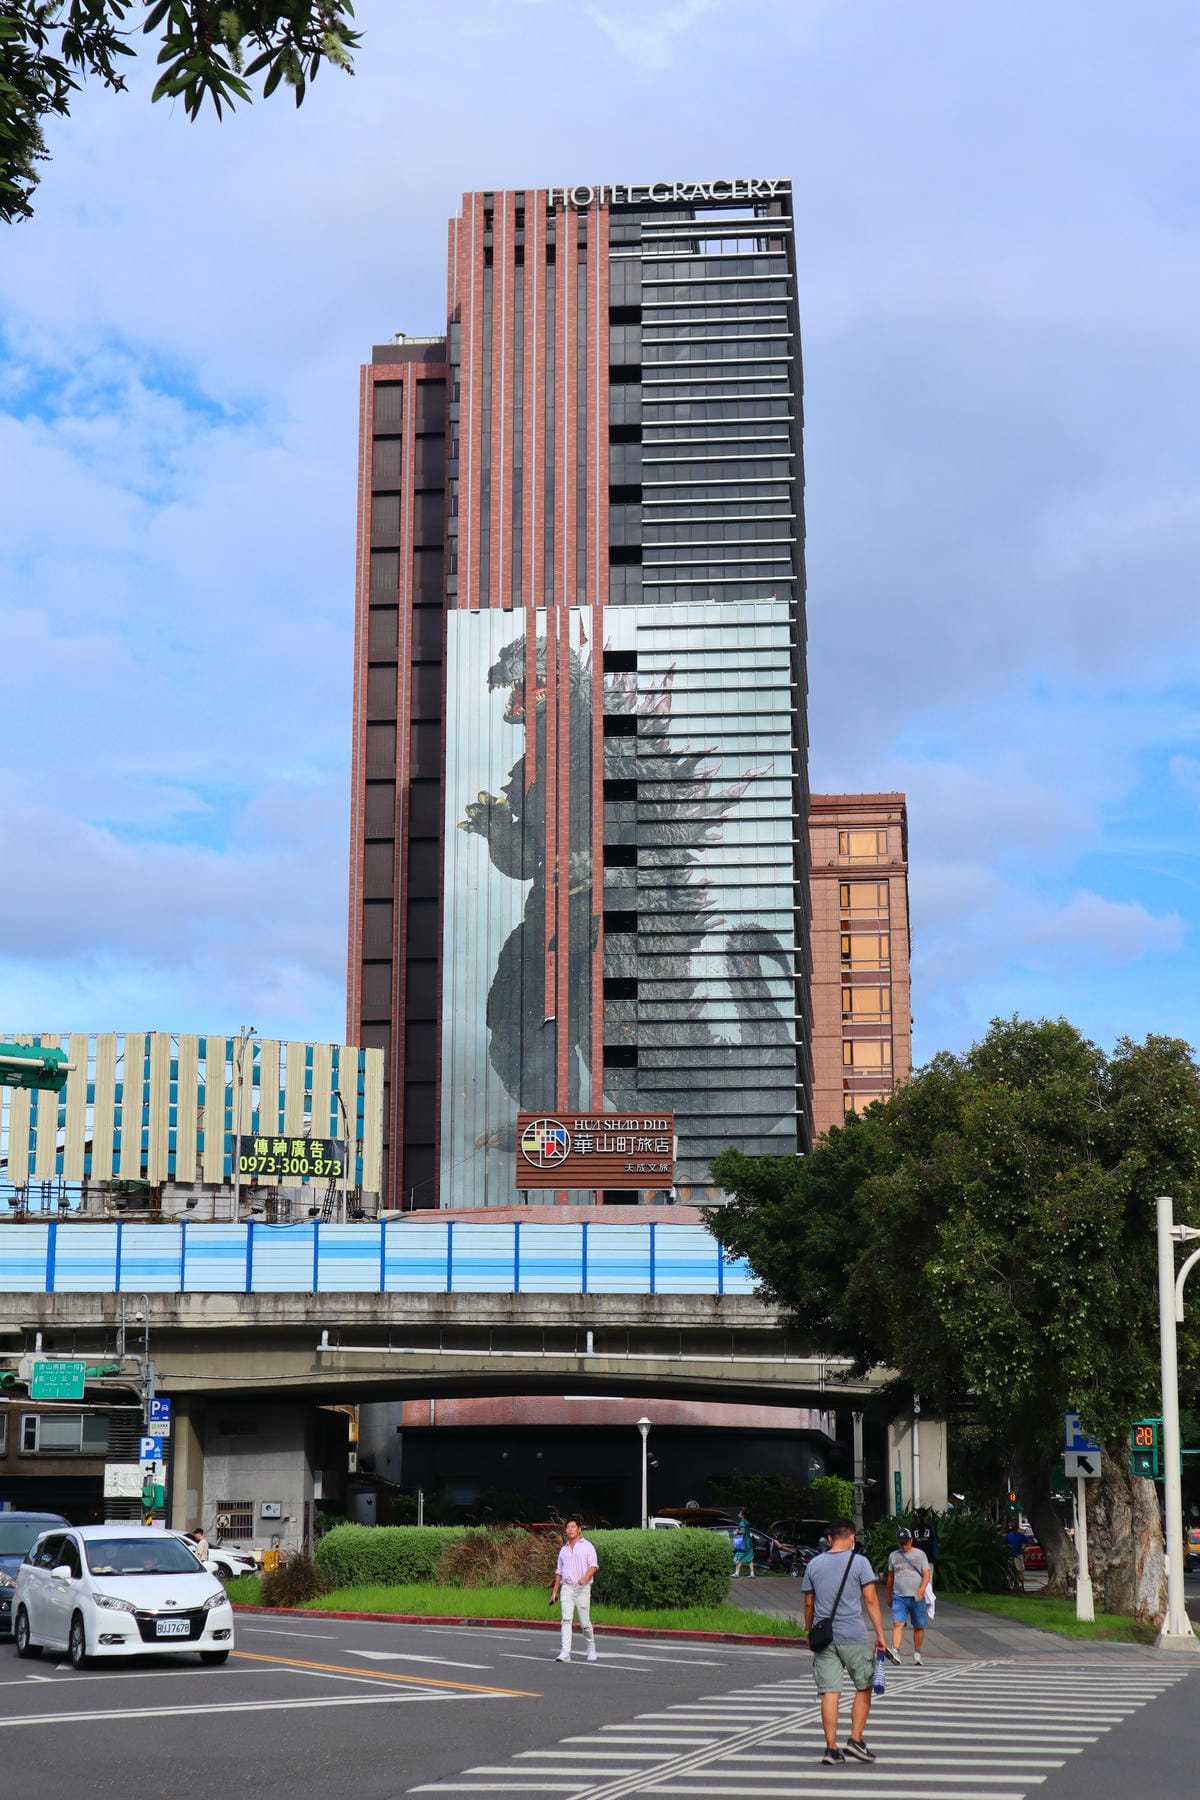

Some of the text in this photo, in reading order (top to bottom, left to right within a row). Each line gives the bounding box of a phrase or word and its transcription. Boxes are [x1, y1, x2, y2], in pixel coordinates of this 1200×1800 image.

[548, 178, 782, 207] HOTEL GRACERY
[574, 1120, 668, 1130] HUA SHAN DIN
[254, 1138, 324, 1158] 傳神廣告
[574, 1133, 669, 1155] 華山町旅店
[240, 1156, 341, 1175] 0973-300-873
[624, 1163, 669, 1173] 天成文旅
[151, 1400, 161, 1416] P
[1135, 1426, 1153, 1446] 28
[140, 1438, 155, 1458] P
